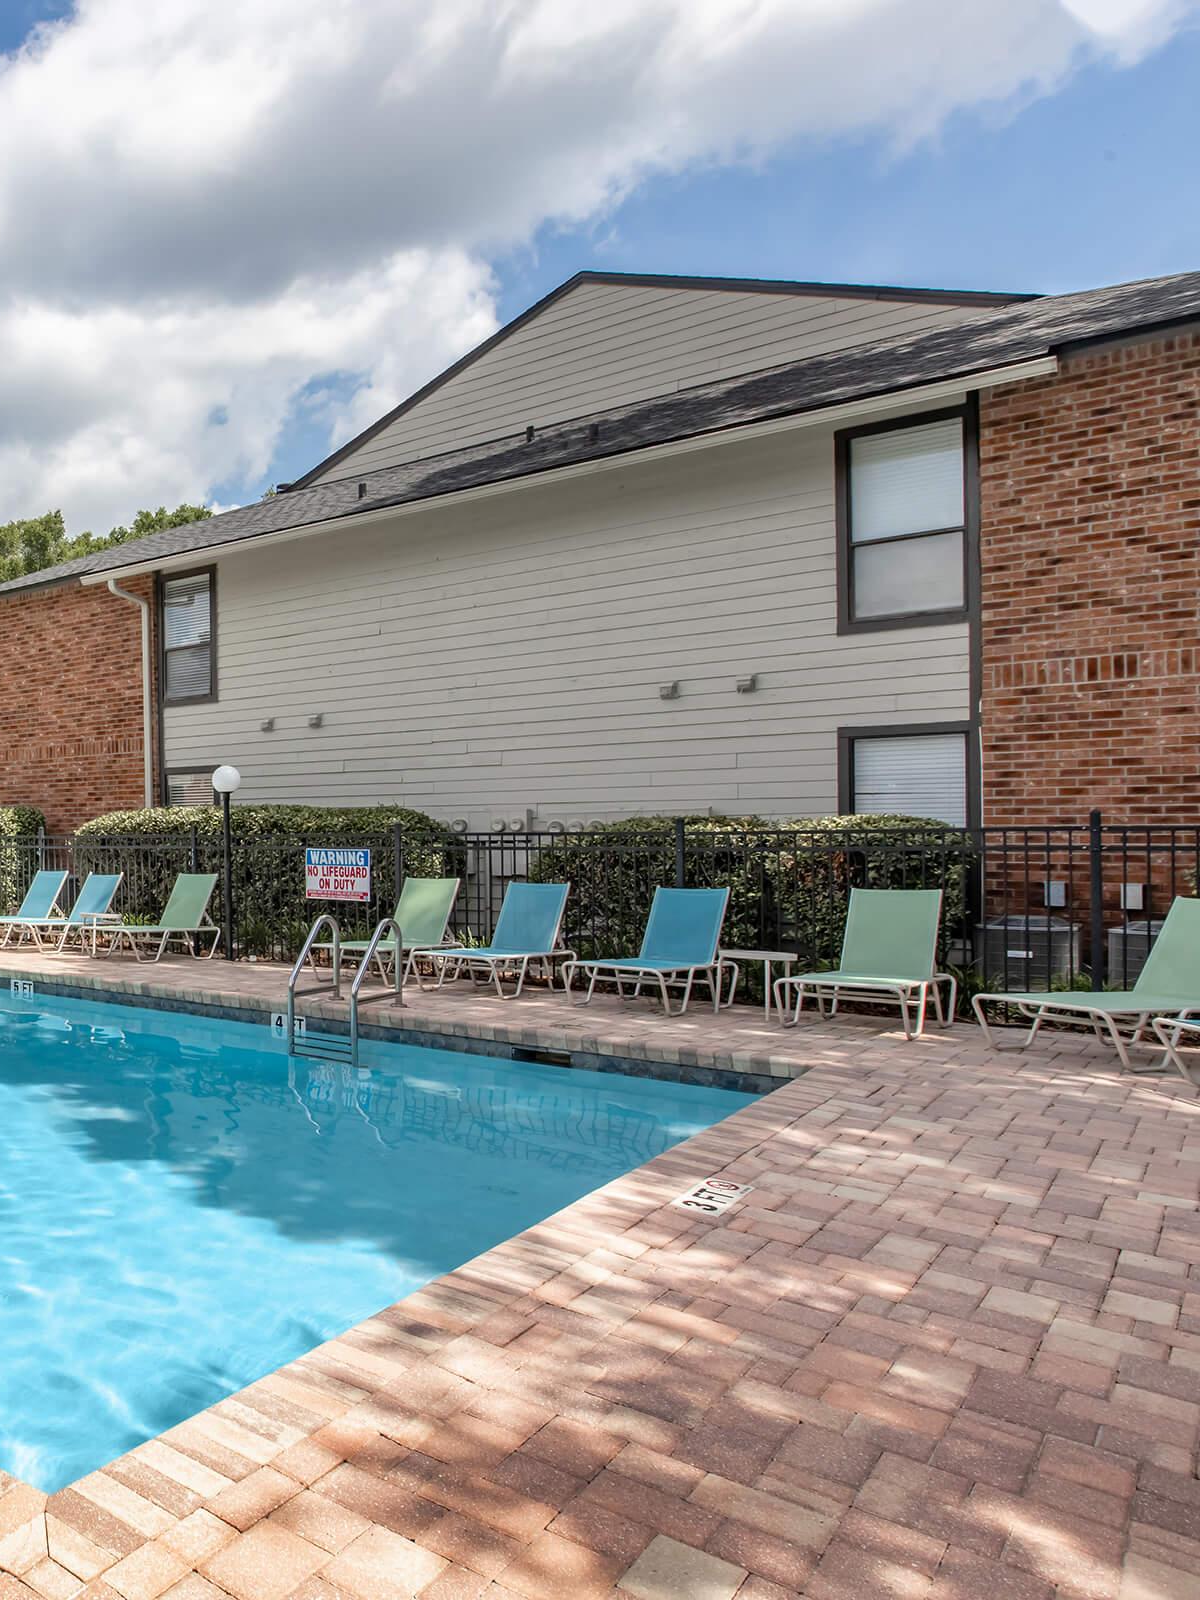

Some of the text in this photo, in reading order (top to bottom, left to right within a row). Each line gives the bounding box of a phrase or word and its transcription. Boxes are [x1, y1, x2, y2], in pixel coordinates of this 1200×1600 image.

[310, 850, 364, 865] WARNING
[307, 865, 368, 878] NO LIFEGUARD
[318, 878, 356, 890] ON DUTY
[13, 981, 32, 992] 5 FT
[275, 1015, 283, 1027] 4
[692, 1188, 734, 1204] FT
[682, 1200, 718, 1211] 3
